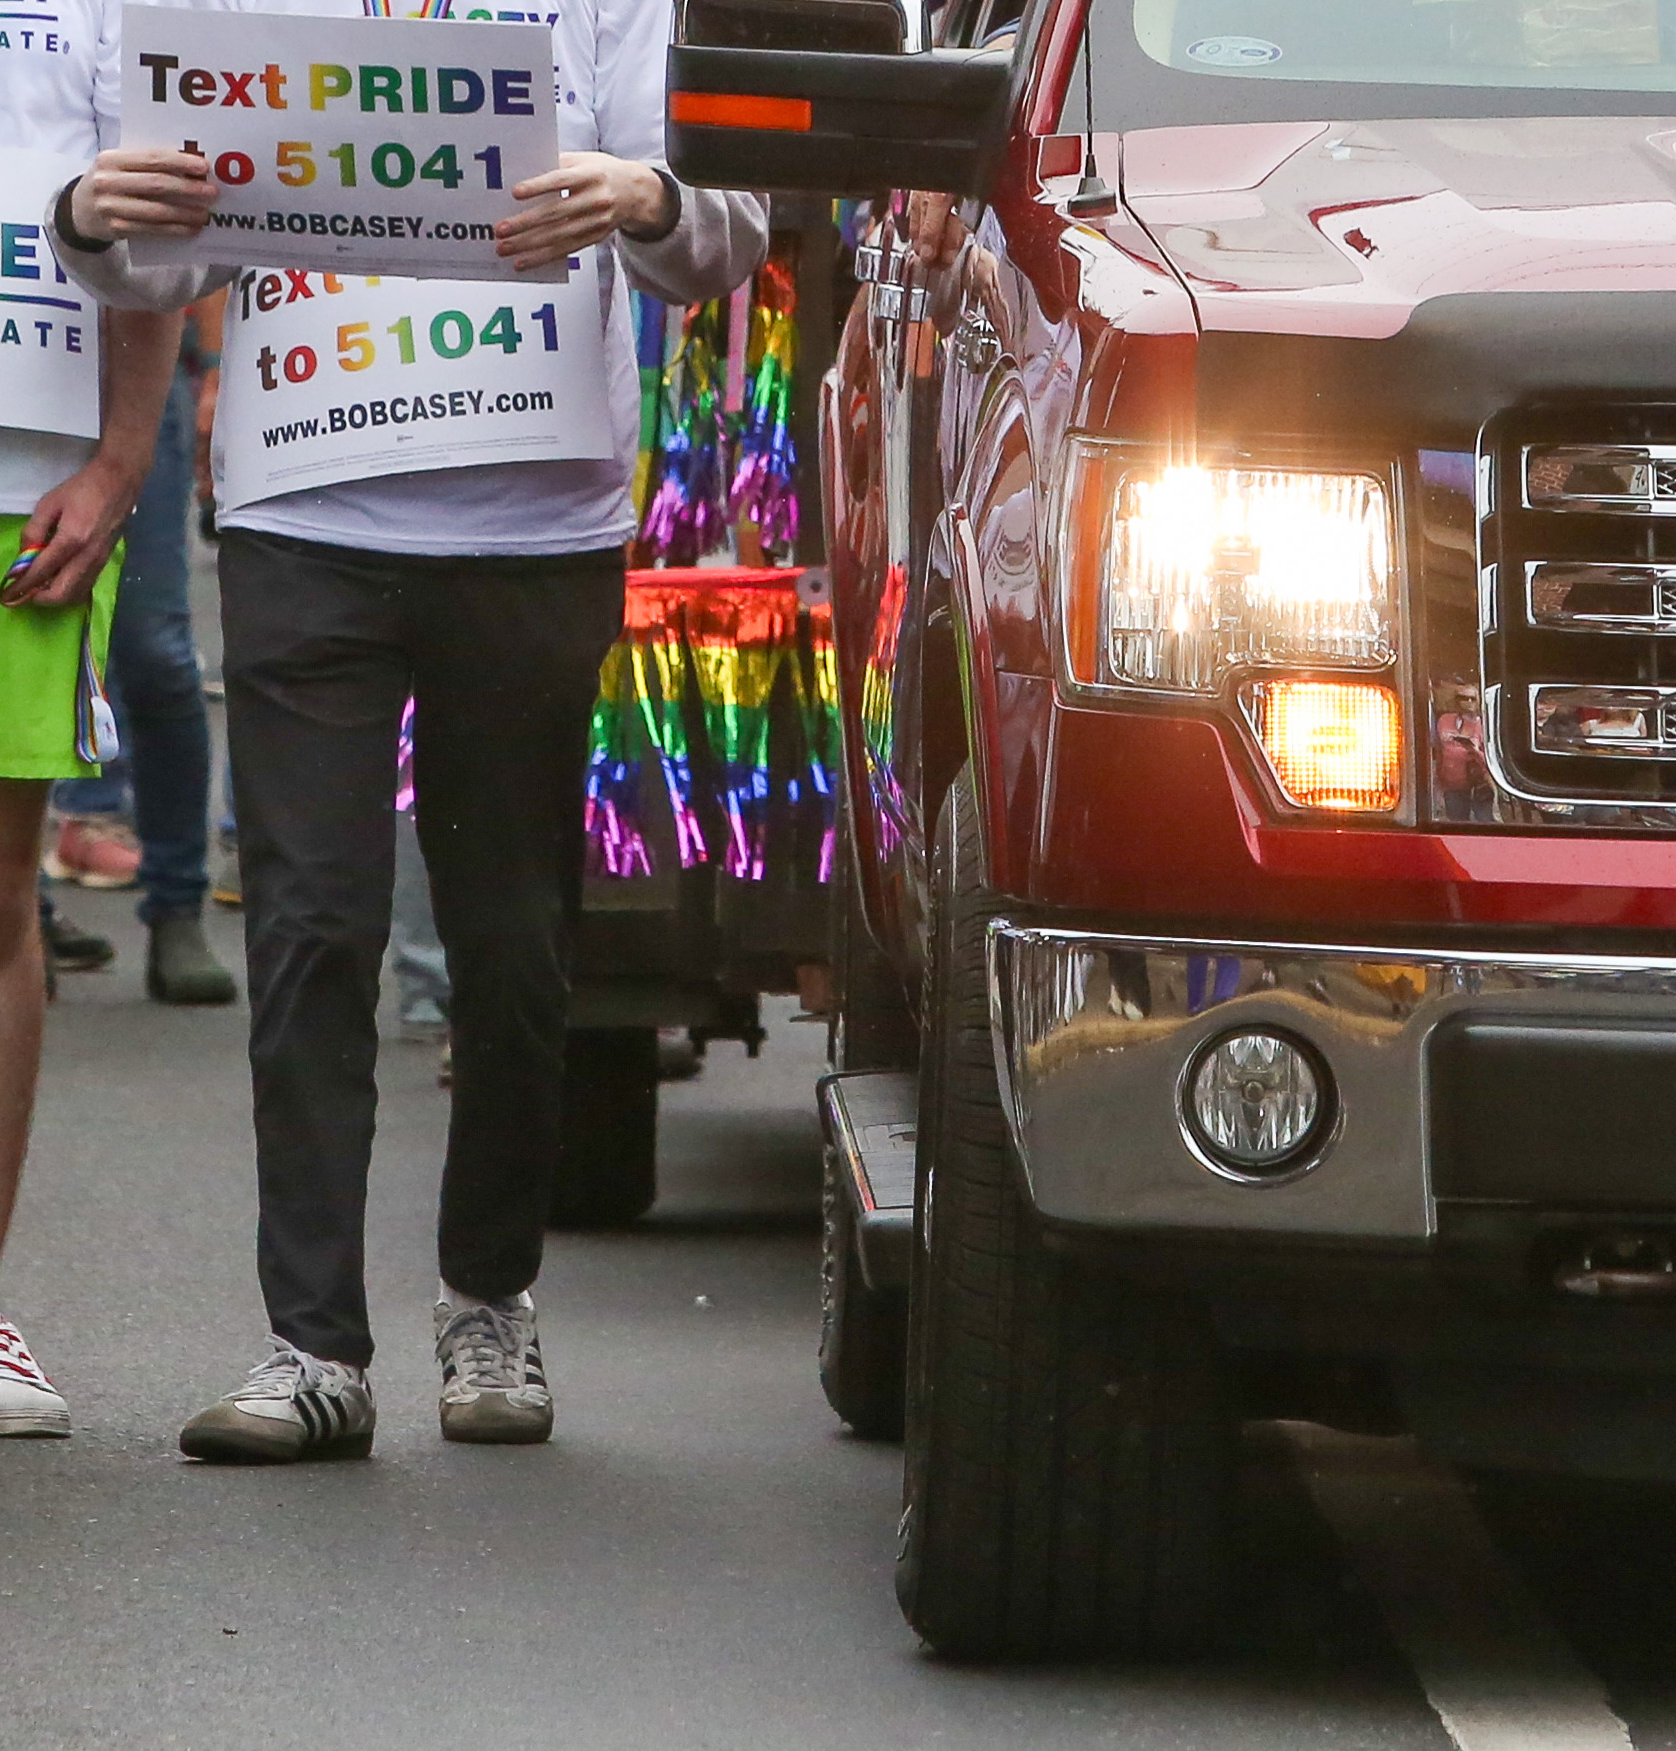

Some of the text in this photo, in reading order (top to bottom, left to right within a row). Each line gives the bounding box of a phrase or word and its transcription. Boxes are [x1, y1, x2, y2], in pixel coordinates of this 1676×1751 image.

[139, 53, 535, 116] Text PRIDE
[276, 141, 504, 190] 51041
[205, 210, 496, 242] ww.BOBCASEY.com
[239, 267, 345, 321] Text
[256, 303, 560, 391] to 51041
[262, 390, 554, 448] www.BOBCASEY.com
